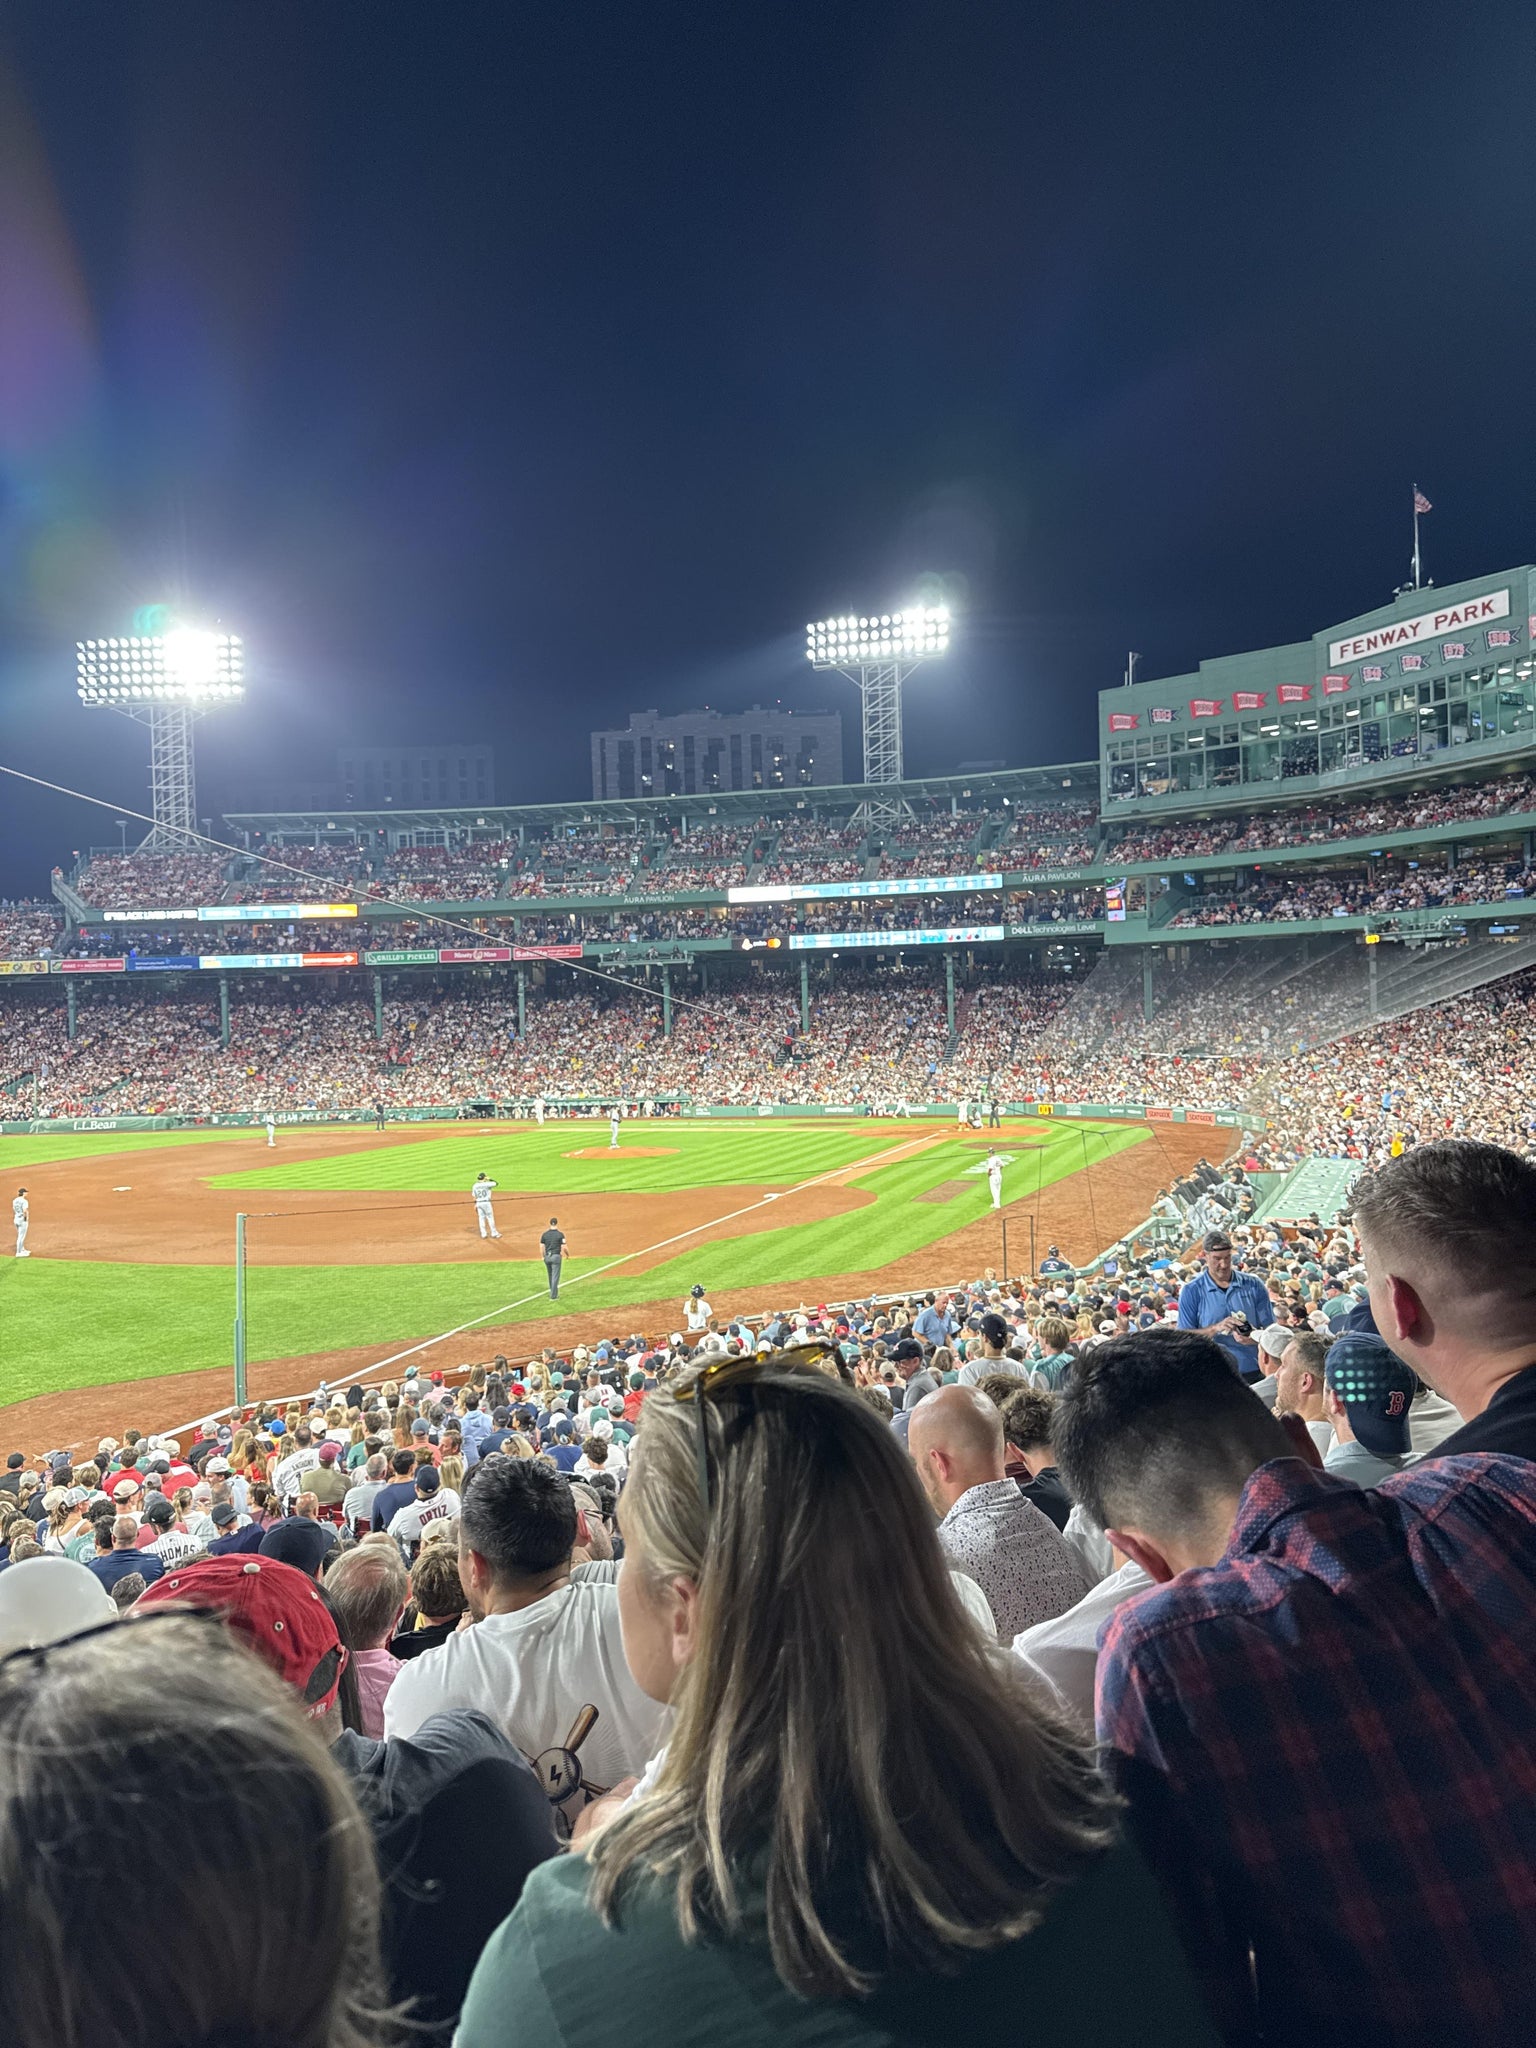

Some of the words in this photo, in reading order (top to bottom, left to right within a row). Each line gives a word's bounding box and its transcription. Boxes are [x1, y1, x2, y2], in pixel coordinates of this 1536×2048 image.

[1339, 621, 1422, 659] FENWAY
[1434, 599, 1495, 630] PARK
[1047, 871, 1081, 881] PAVILION
[645, 894, 675, 904] PAVILION
[1011, 926, 1033, 935] DELL
[1033, 923, 1076, 934] Technologies
[1077, 922, 1096, 932] Level
[376, 953, 405, 962] GRILLO'S
[407, 952, 435, 961] PICKLES
[454, 952, 472, 960] Ninety
[73, 1120, 117, 1131] L.L.Bean
[1385, 1391, 1405, 1415] B
[418, 1504, 449, 1527] ORTIZ
[157, 1543, 196, 1563] HOMAS
